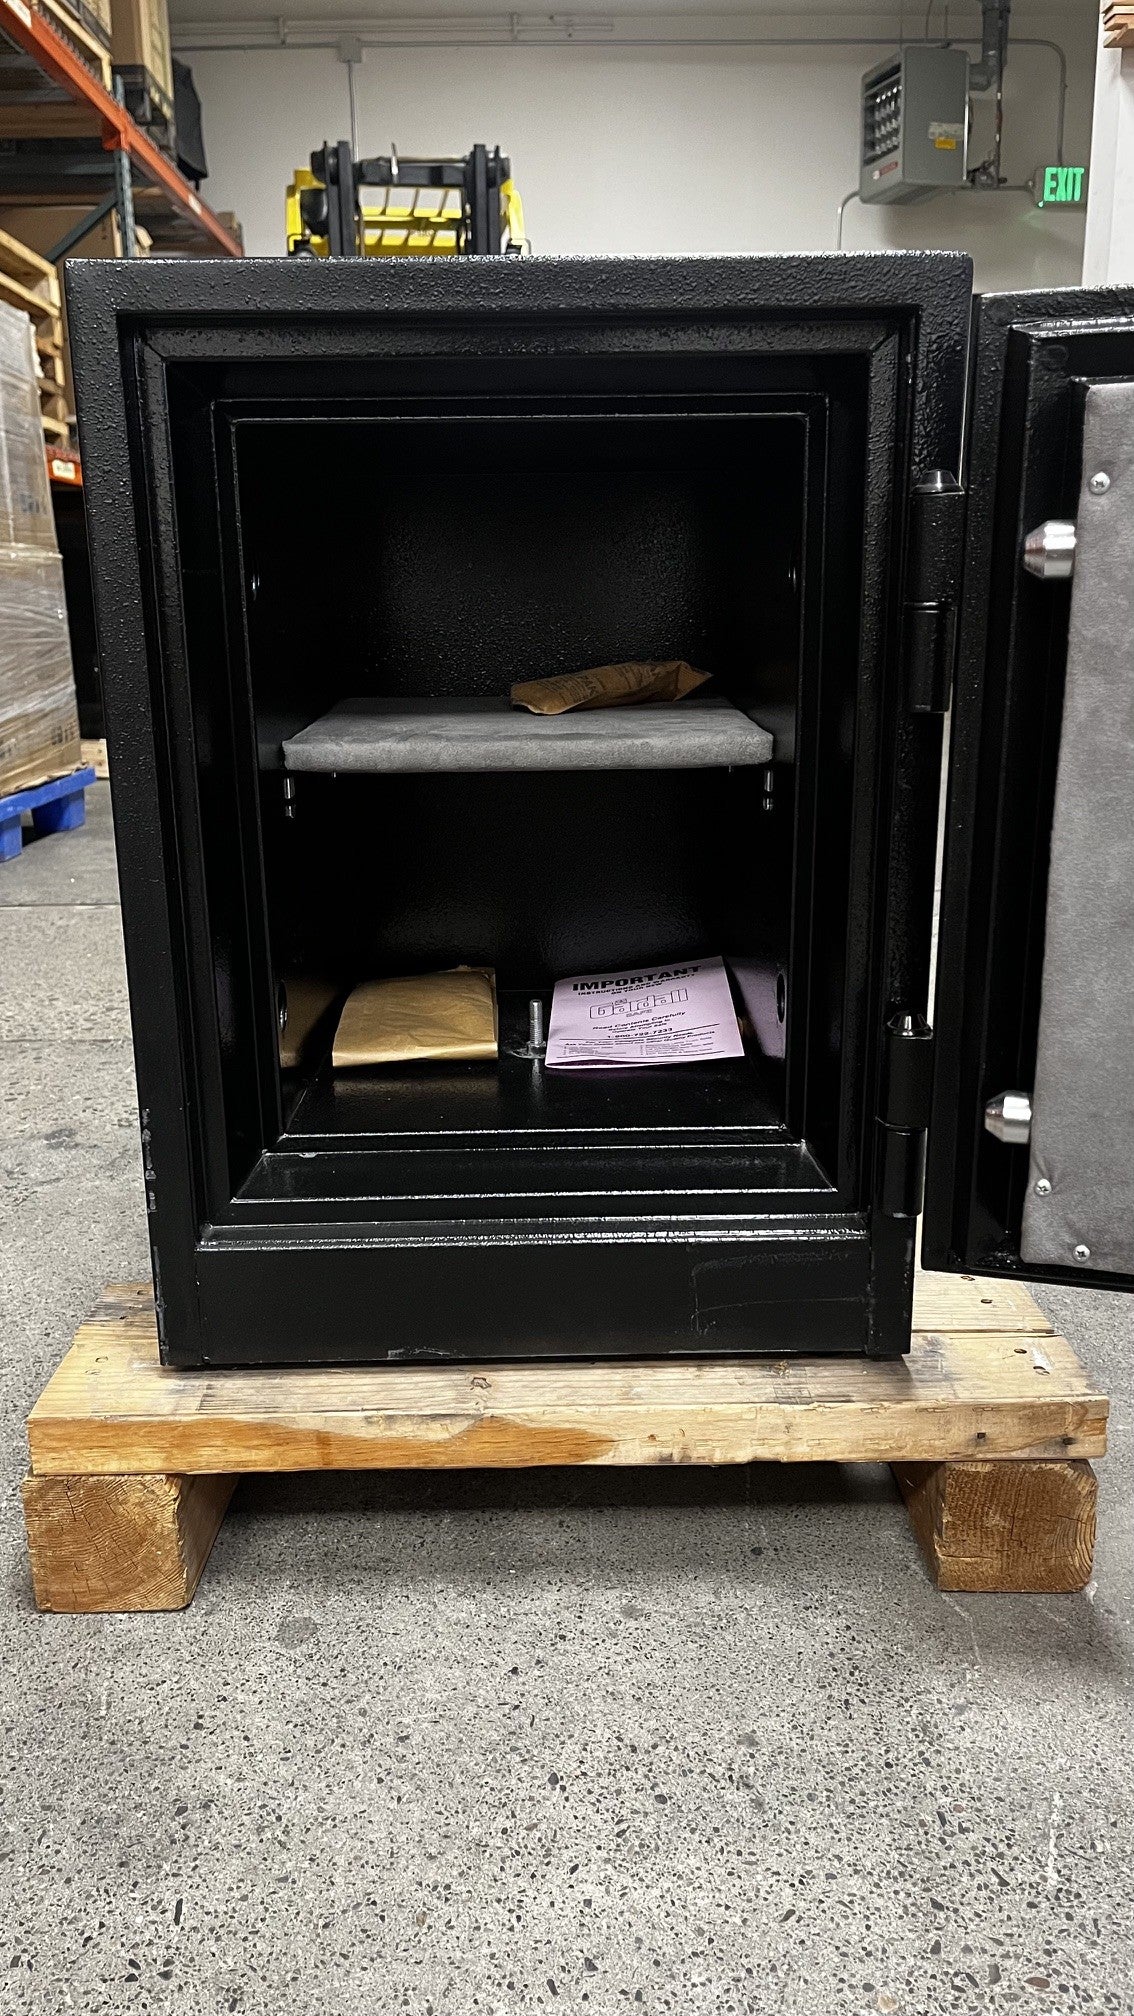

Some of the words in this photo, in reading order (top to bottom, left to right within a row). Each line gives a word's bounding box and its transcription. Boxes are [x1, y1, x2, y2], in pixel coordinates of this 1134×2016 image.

[1044, 167, 1085, 202] EXIT
[573, 965, 702, 991] IMPORTANT
[578, 985, 633, 996] INSTRUCTIONS
[653, 974, 695, 984] WARRANTY
[652, 1012, 685, 1022] Carefully
